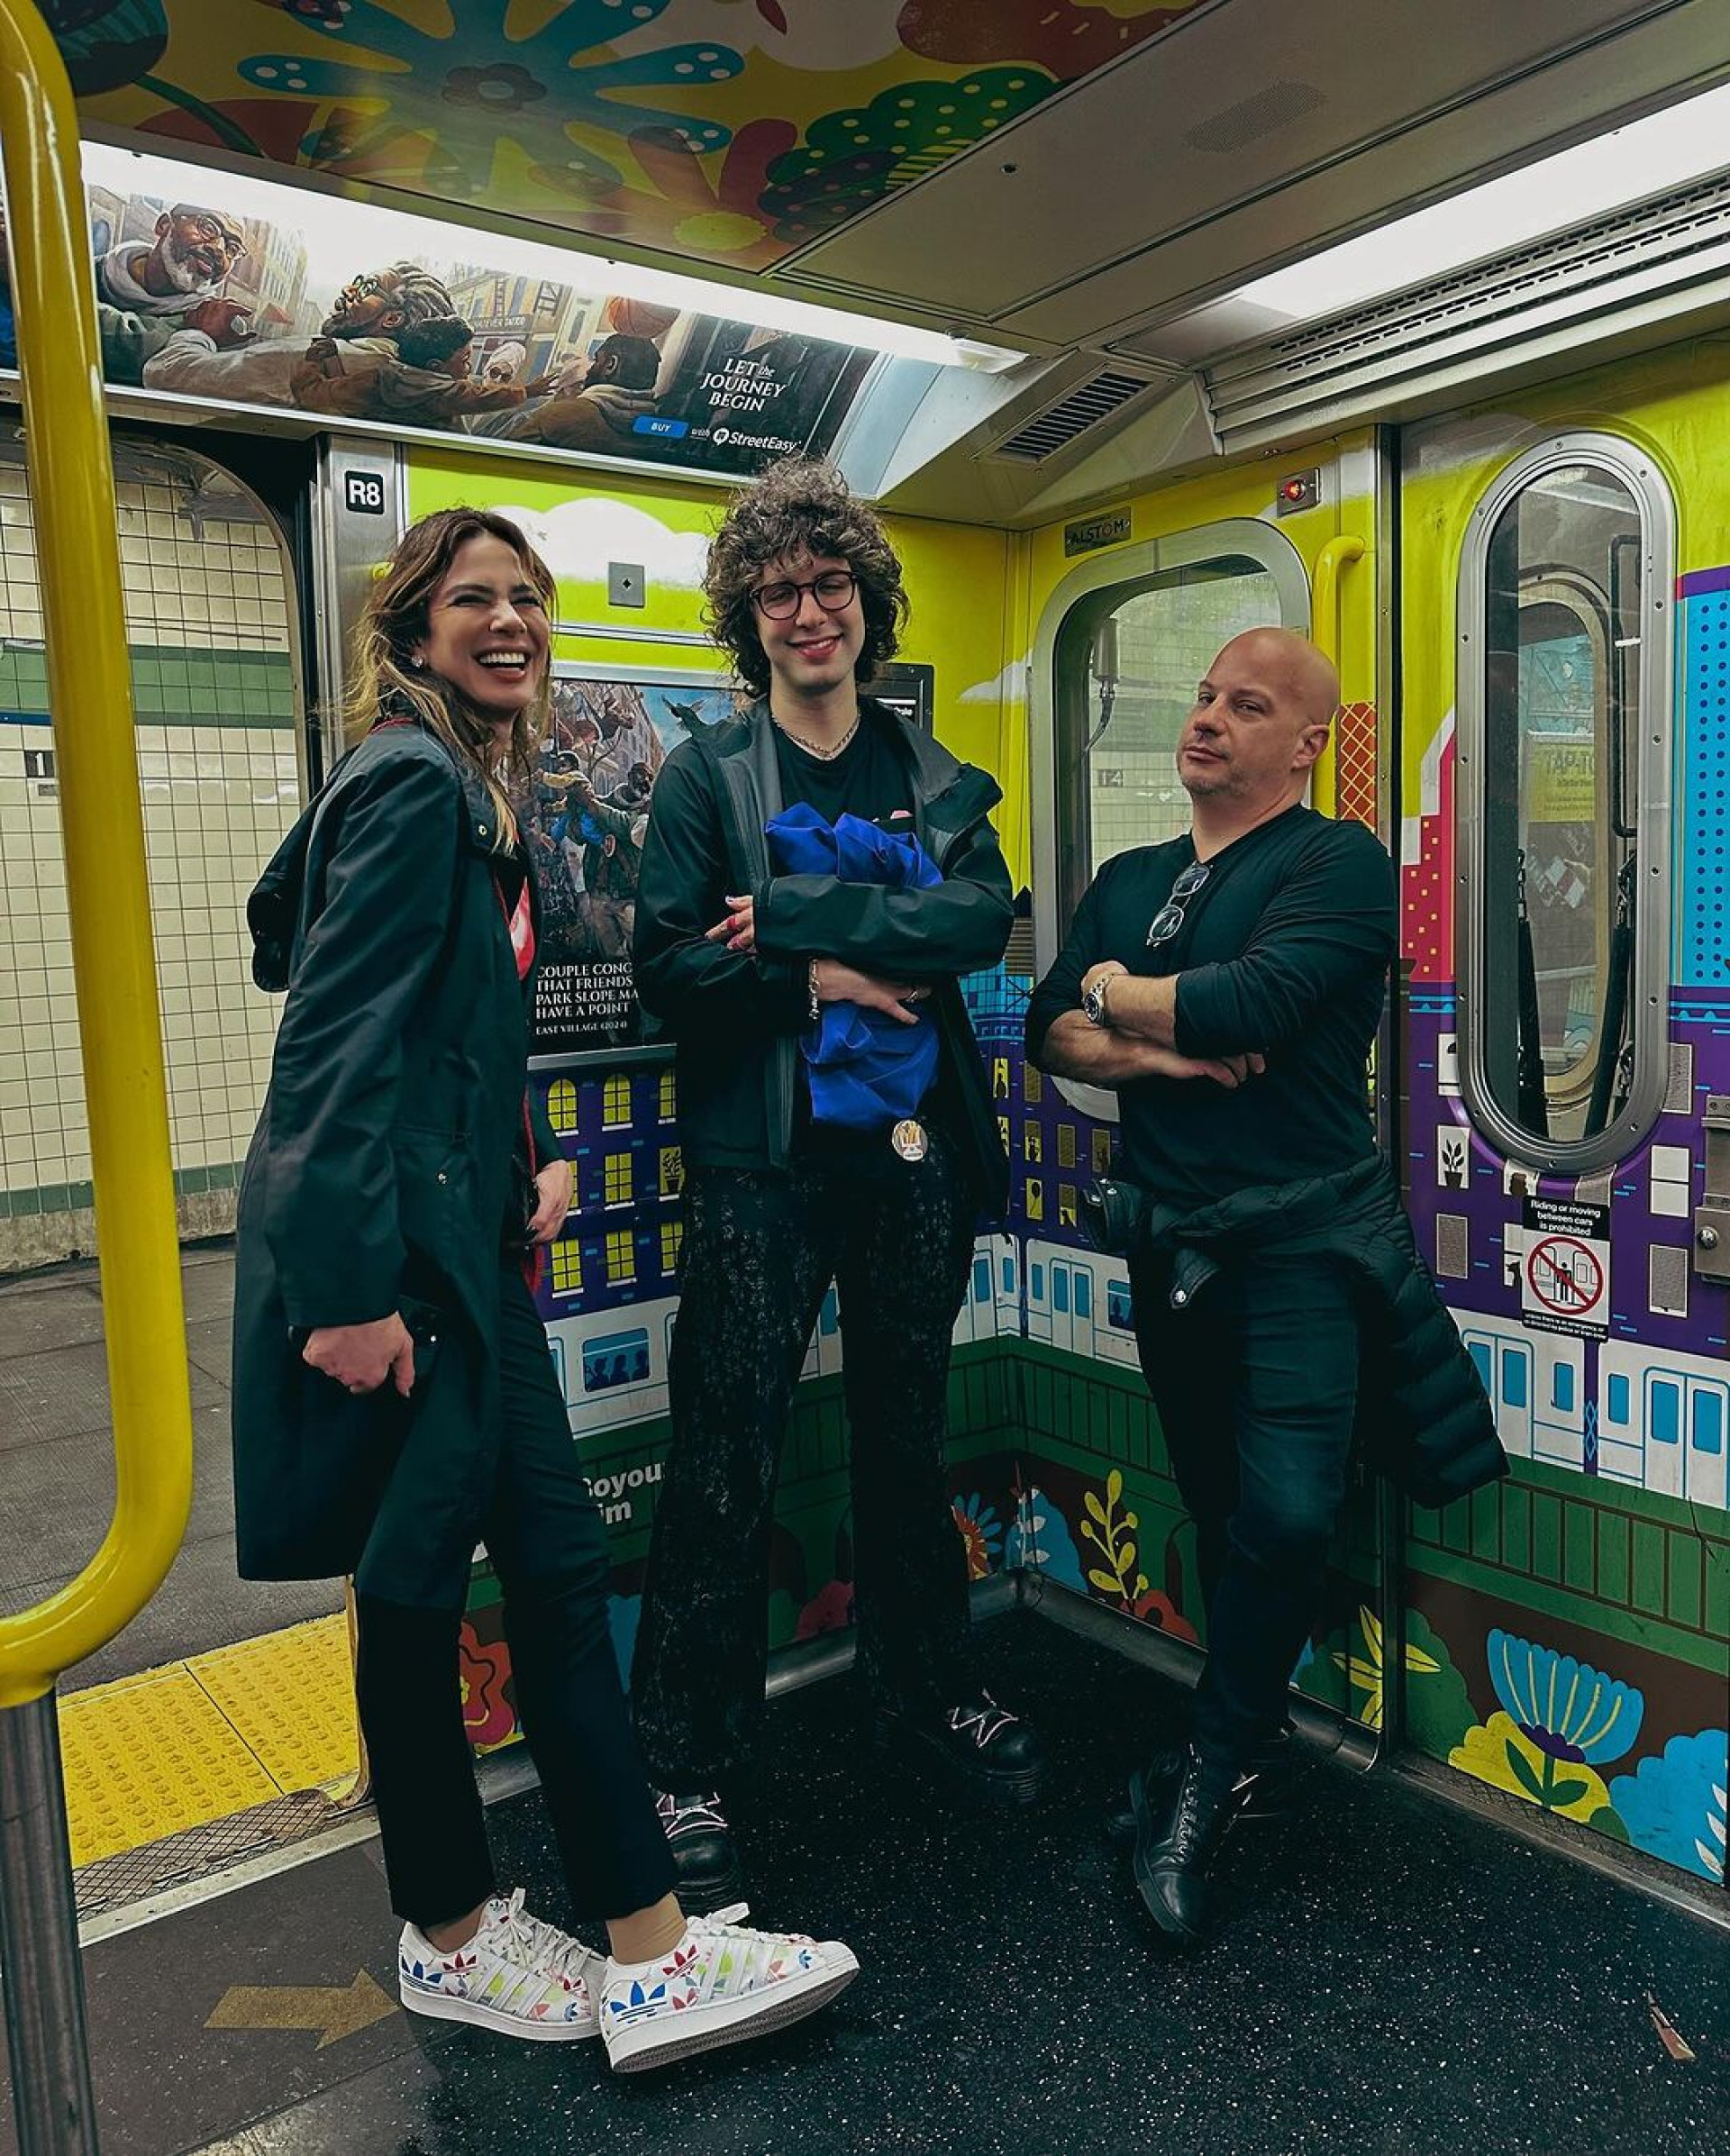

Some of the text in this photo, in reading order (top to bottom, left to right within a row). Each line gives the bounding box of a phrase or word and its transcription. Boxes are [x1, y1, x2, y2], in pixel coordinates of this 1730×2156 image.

[724, 358, 776, 379] LET the
[699, 372, 788, 398] JOURNEY
[707, 391, 765, 413] BEGIN
[651, 422, 672, 432] BUY
[728, 432, 798, 454] StreetEasy
[349, 478, 380, 506] R8
[1101, 769, 1124, 786] 14
[537, 975, 633, 992] THAT FRIENDS
[535, 992, 572, 1005] PARK
[575, 989, 615, 1004] SLOPE
[535, 1001, 630, 1019] HAVE A POINT
[535, 1024, 559, 1035] EAST
[560, 1023, 597, 1033] VILLAGE
[1531, 1199, 1601, 1218] Riding or moving
[1537, 1210, 1593, 1226] between cars
[1539, 1221, 1592, 1236] is prohibited
